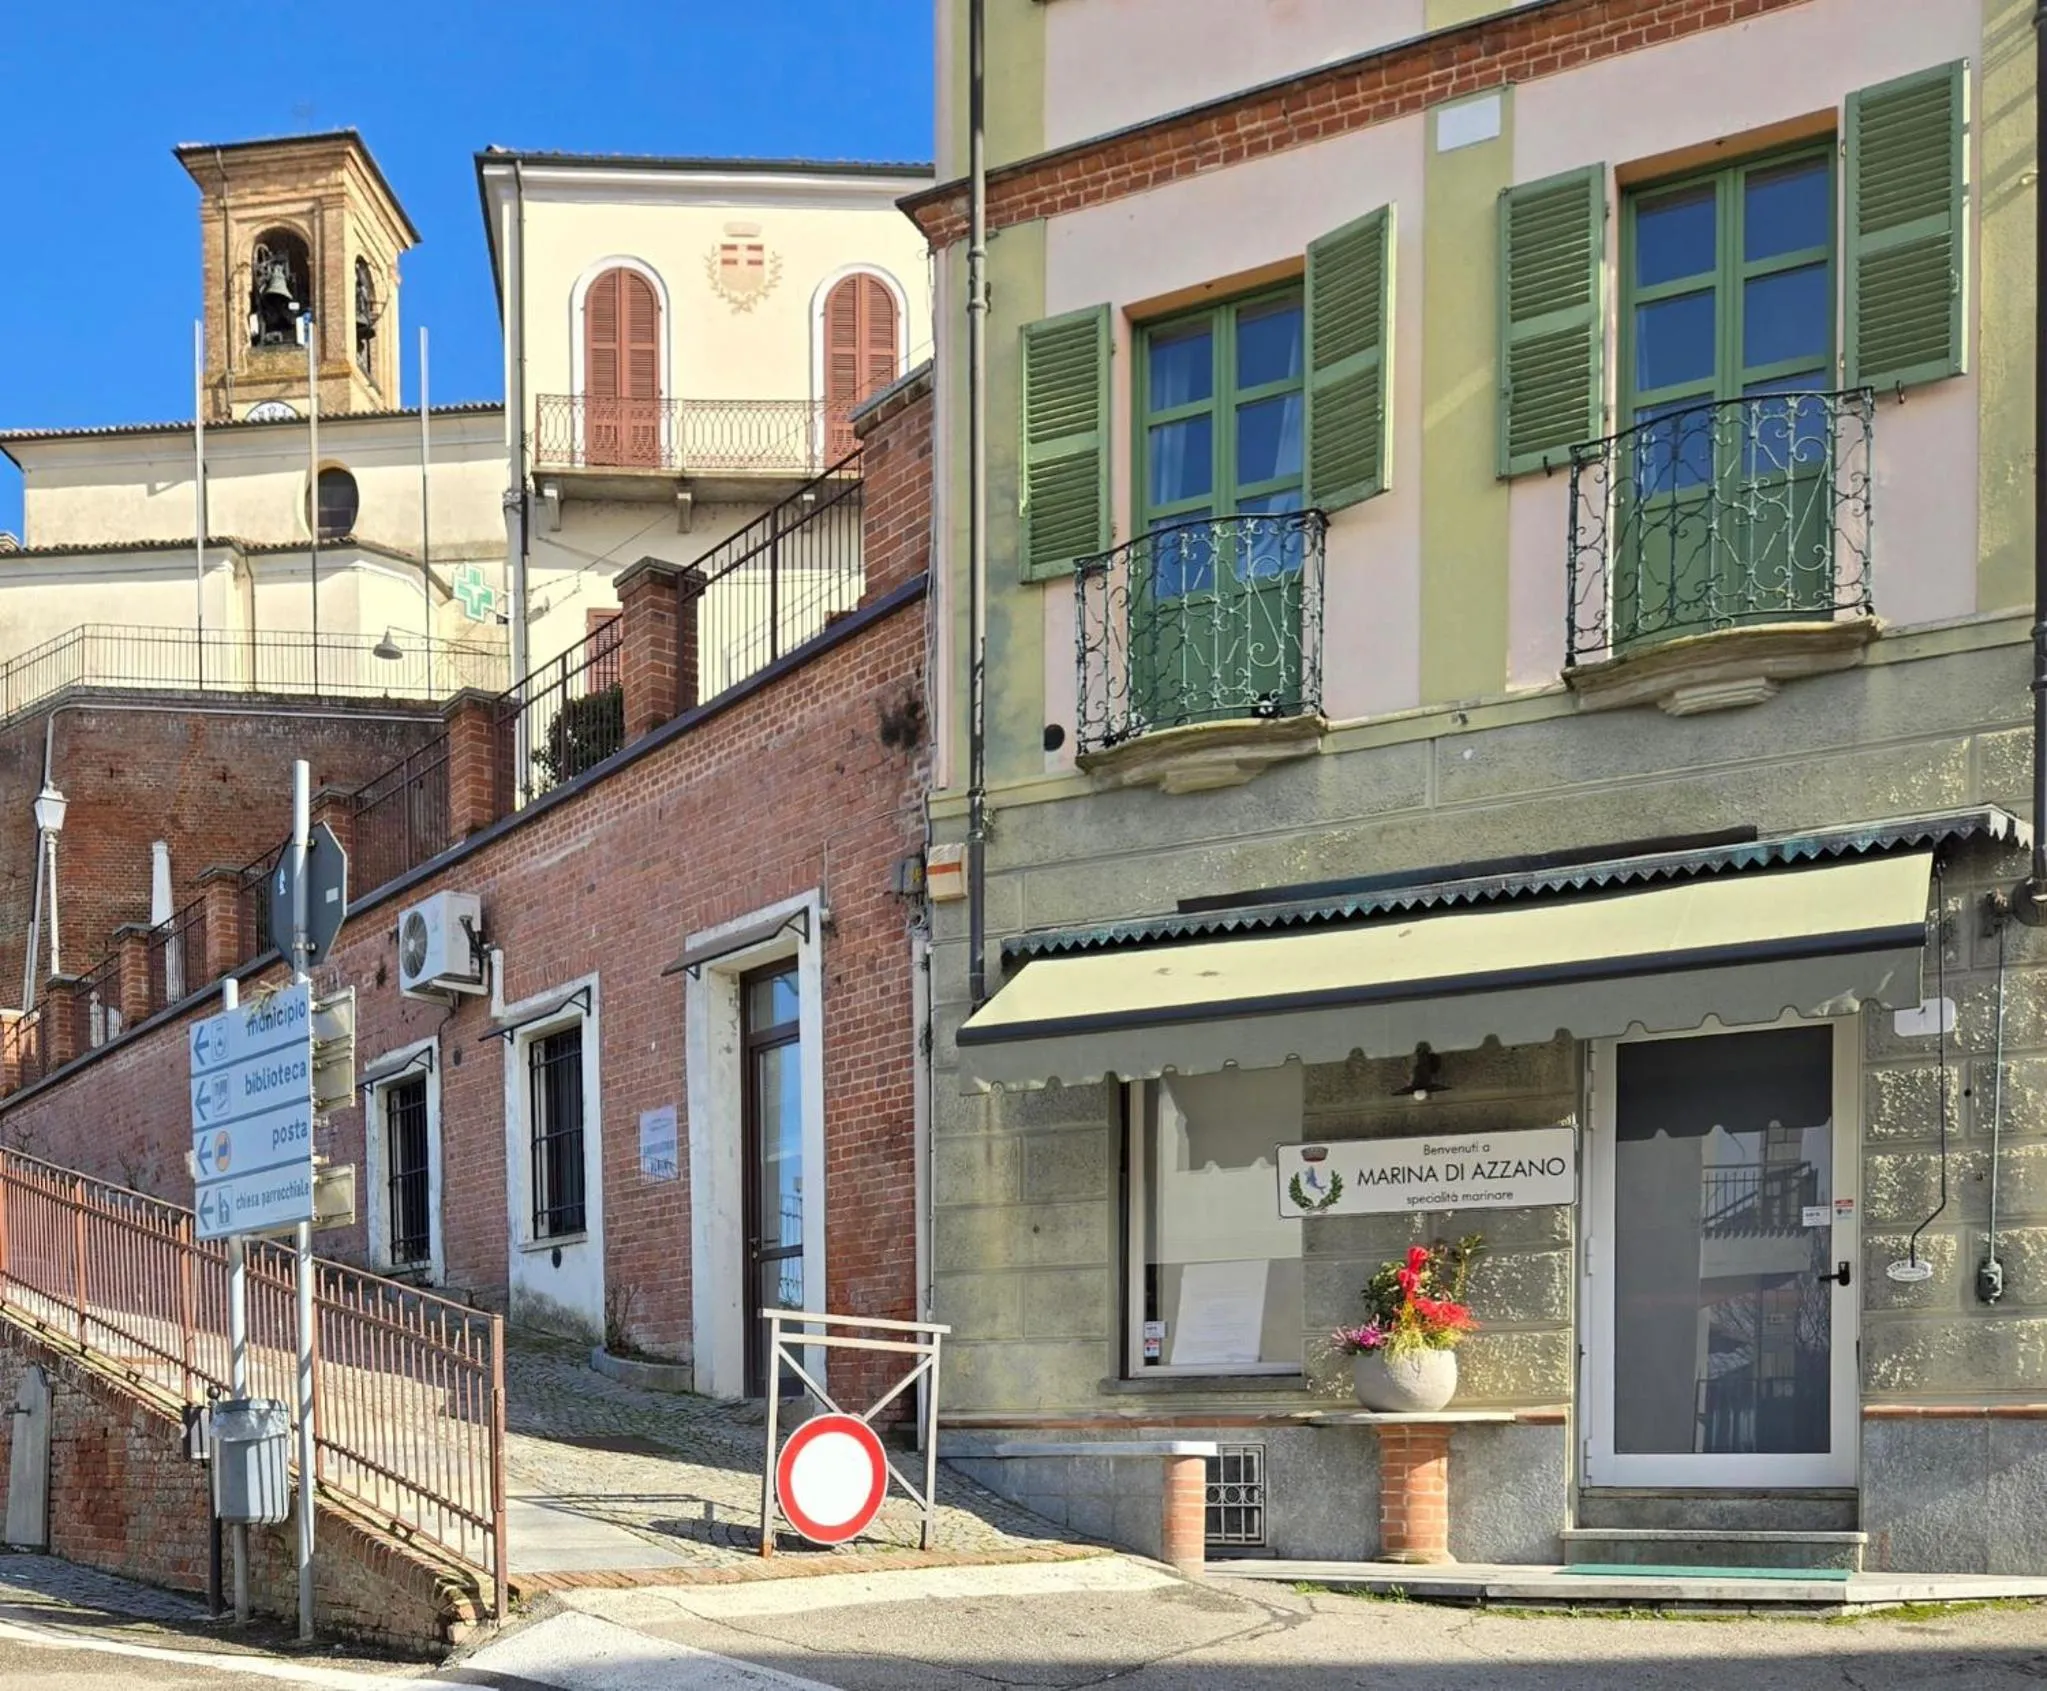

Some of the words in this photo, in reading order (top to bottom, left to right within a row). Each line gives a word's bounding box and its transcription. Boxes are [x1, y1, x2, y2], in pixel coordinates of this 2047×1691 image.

[246, 997, 307, 1037] municipio
[245, 1060, 307, 1096] biblioteca
[272, 1120, 308, 1150] posta
[1423, 1142, 1481, 1156] Benvenuti
[1482, 1143, 1490, 1153] a
[1357, 1165, 1438, 1187] MARINA
[1445, 1163, 1465, 1182] DI
[1471, 1157, 1566, 1180] AZZANO
[236, 1191, 260, 1210] chiesa
[261, 1179, 309, 1208] parrocchiale
[1406, 1190, 1459, 1206] specialità
[1461, 1189, 1514, 1203] marinare
